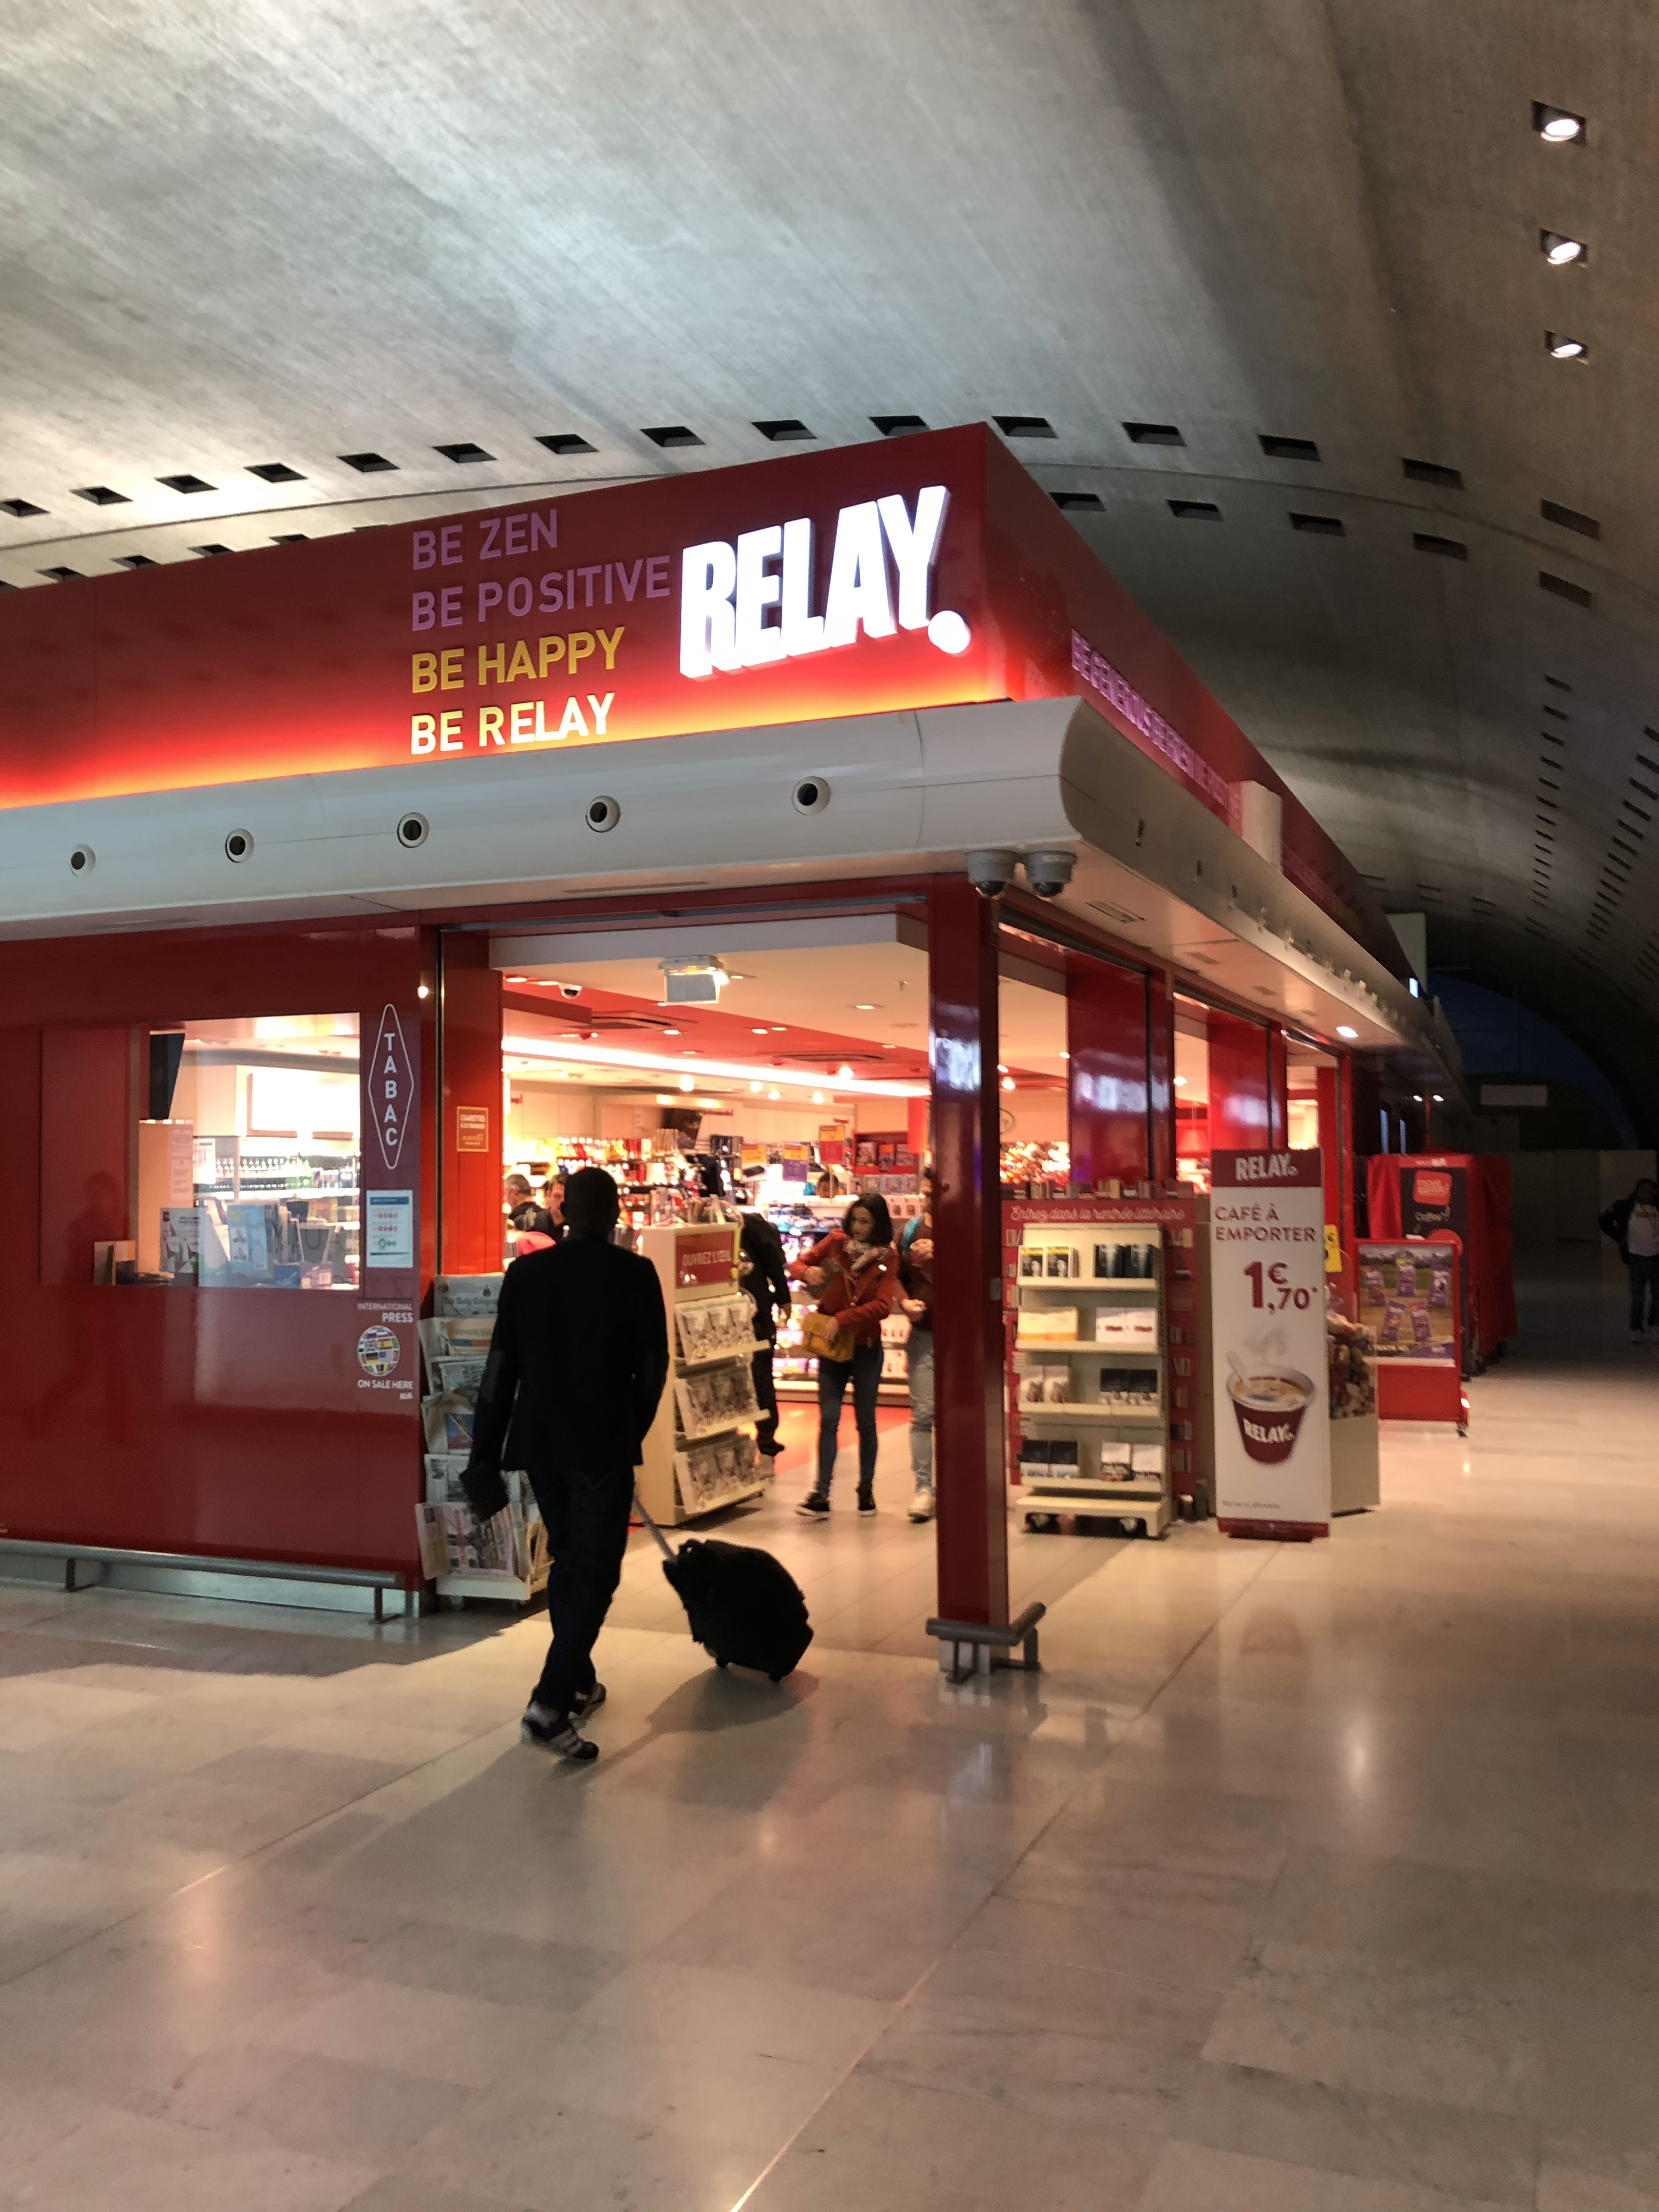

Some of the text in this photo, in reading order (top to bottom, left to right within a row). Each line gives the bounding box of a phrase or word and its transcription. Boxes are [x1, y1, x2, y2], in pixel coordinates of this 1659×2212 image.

[413, 508, 557, 571] BE ZEN
[412, 555, 670, 631] BE POSITIVE
[412, 626, 625, 693] BE HAPPY
[411, 692, 615, 755] BE RELAY
[383, 1032, 398, 1146] TABAC
[1215, 1226, 1317, 1242] EMPORTER
[357, 1302, 413, 1311] INTERNATIONAL
[382, 1312, 413, 1323] PRESS
[358, 1379, 413, 1390] ON SALE HERE
